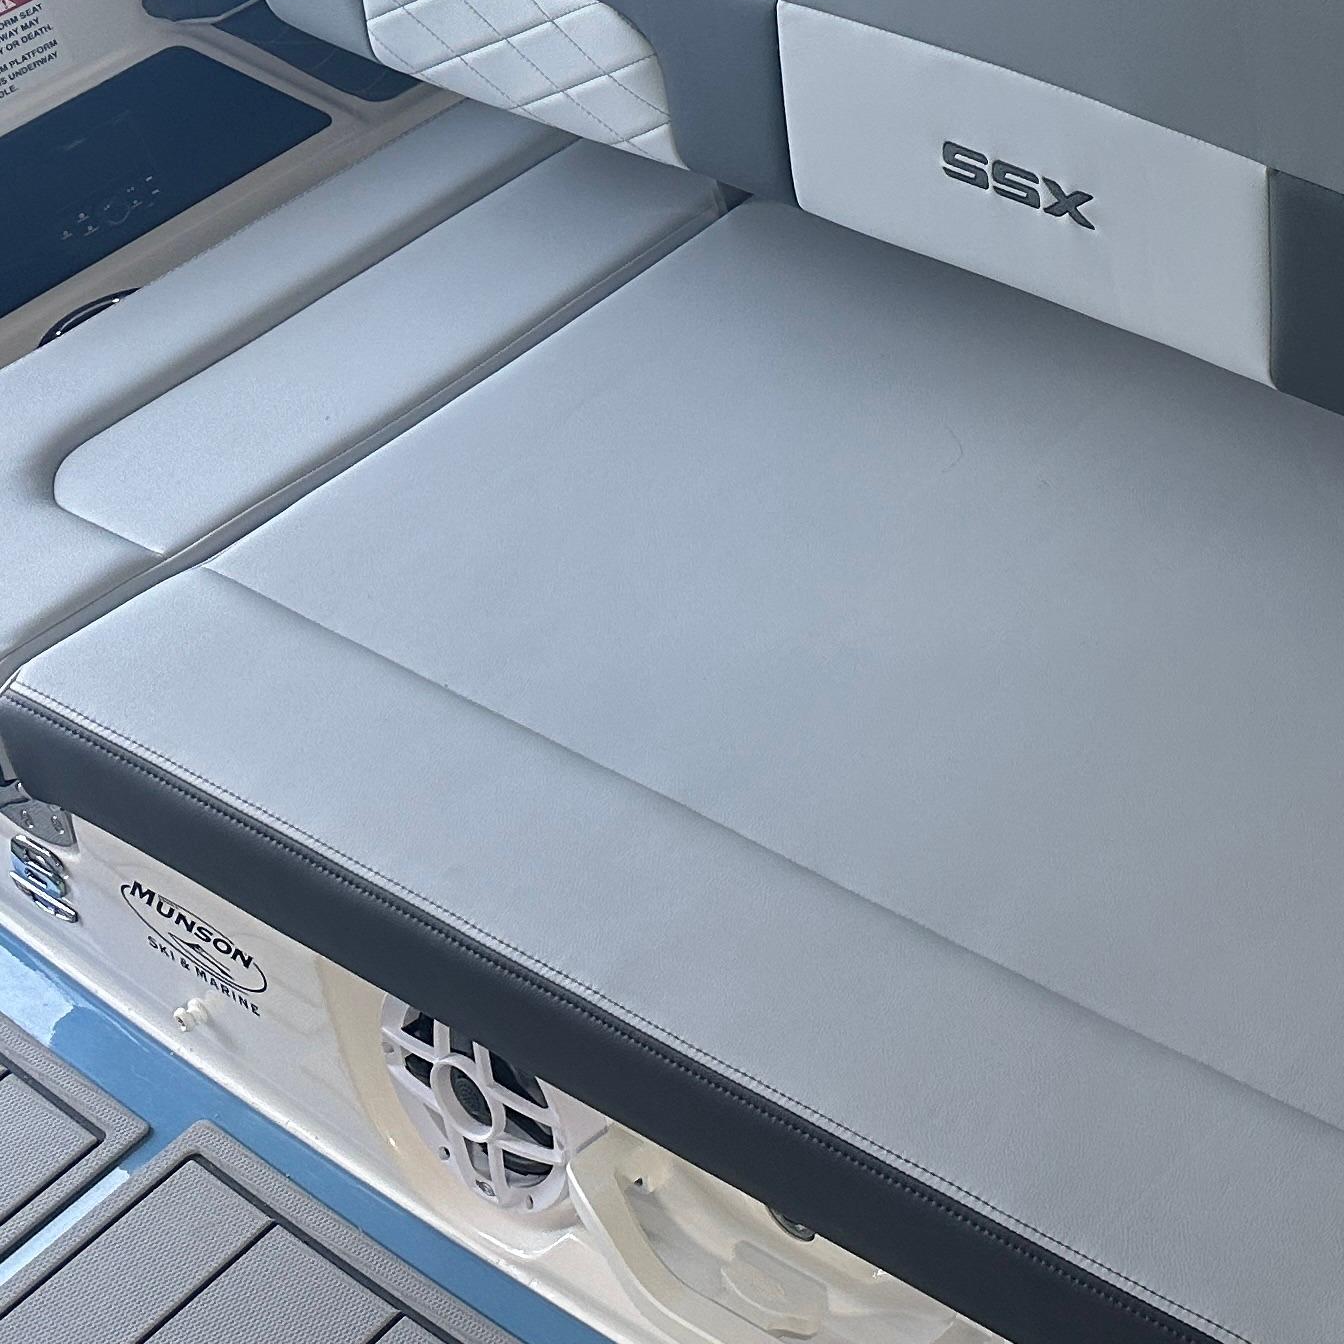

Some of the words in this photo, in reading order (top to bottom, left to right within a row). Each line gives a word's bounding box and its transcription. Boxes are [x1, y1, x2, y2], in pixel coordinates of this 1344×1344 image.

[19, 2, 43, 17] SEAT
[20, 16, 40, 32] MAY
[5, 40, 20, 51] OR
[21, 23, 54, 44] DEATH.
[8, 51, 58, 80] UNDERWAY
[9, 38, 58, 68] PLATFORM
[942, 141, 1096, 231] SSX
[129, 880, 254, 969] MUNSON
[147, 935, 175, 961] SKI
[180, 957, 191, 972] &
[195, 966, 261, 1017] MARINE
